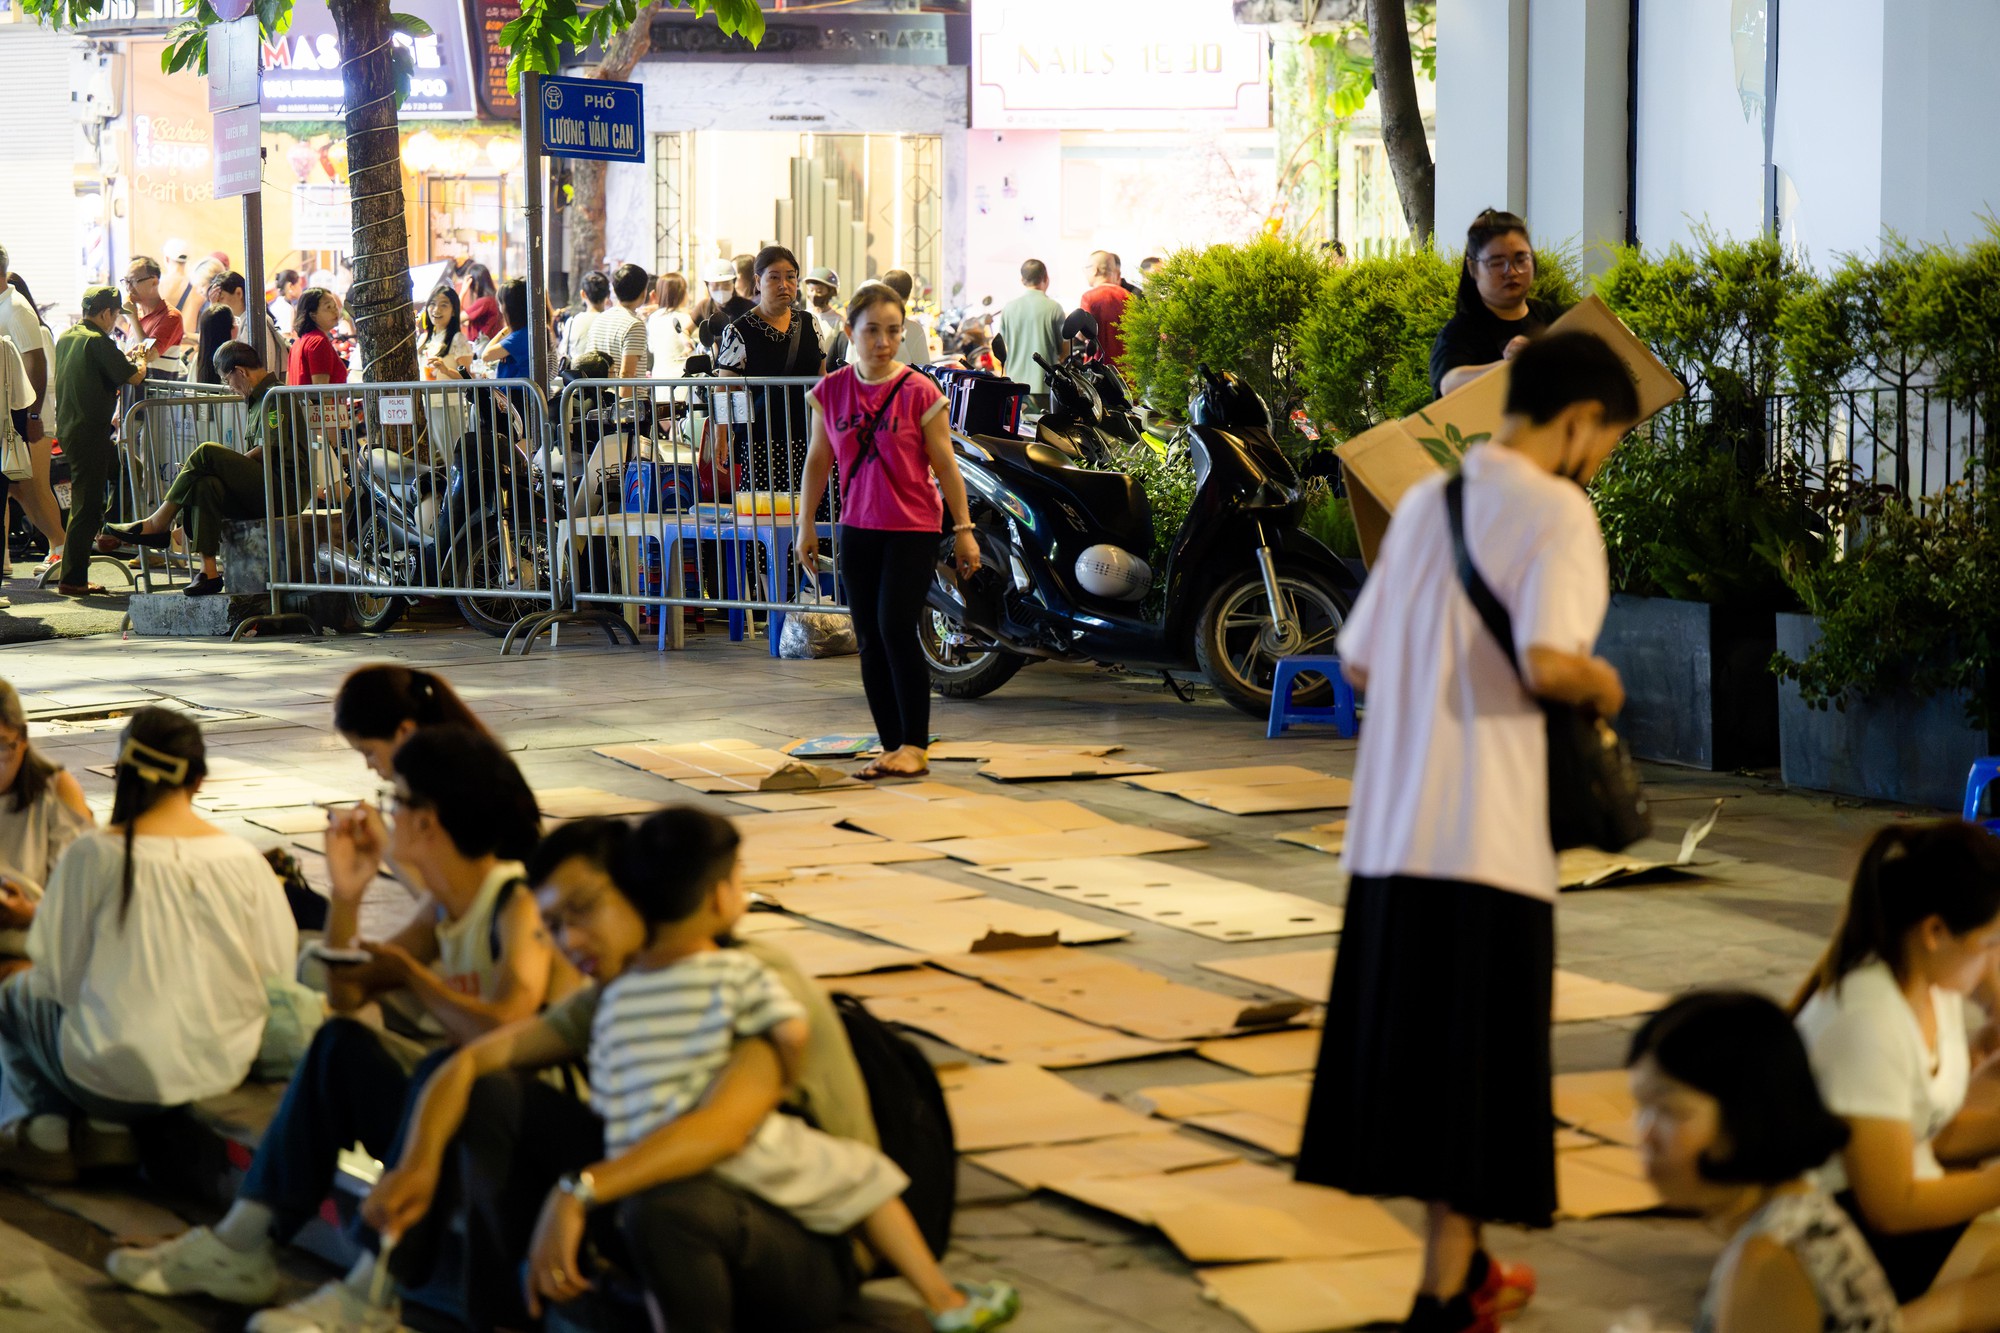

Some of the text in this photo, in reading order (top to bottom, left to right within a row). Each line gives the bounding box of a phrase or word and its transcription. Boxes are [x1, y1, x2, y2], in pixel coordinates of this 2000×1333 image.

[1017, 43, 1115, 75] NAILS
[584, 91, 615, 109] PHỐ
[152, 116, 209, 142] Barber
[549, 115, 634, 150] LƯƠNG VĂN CAN
[151, 144, 210, 168] SHOP
[135, 172, 177, 203] Craft
[387, 409, 408, 419] STOP
